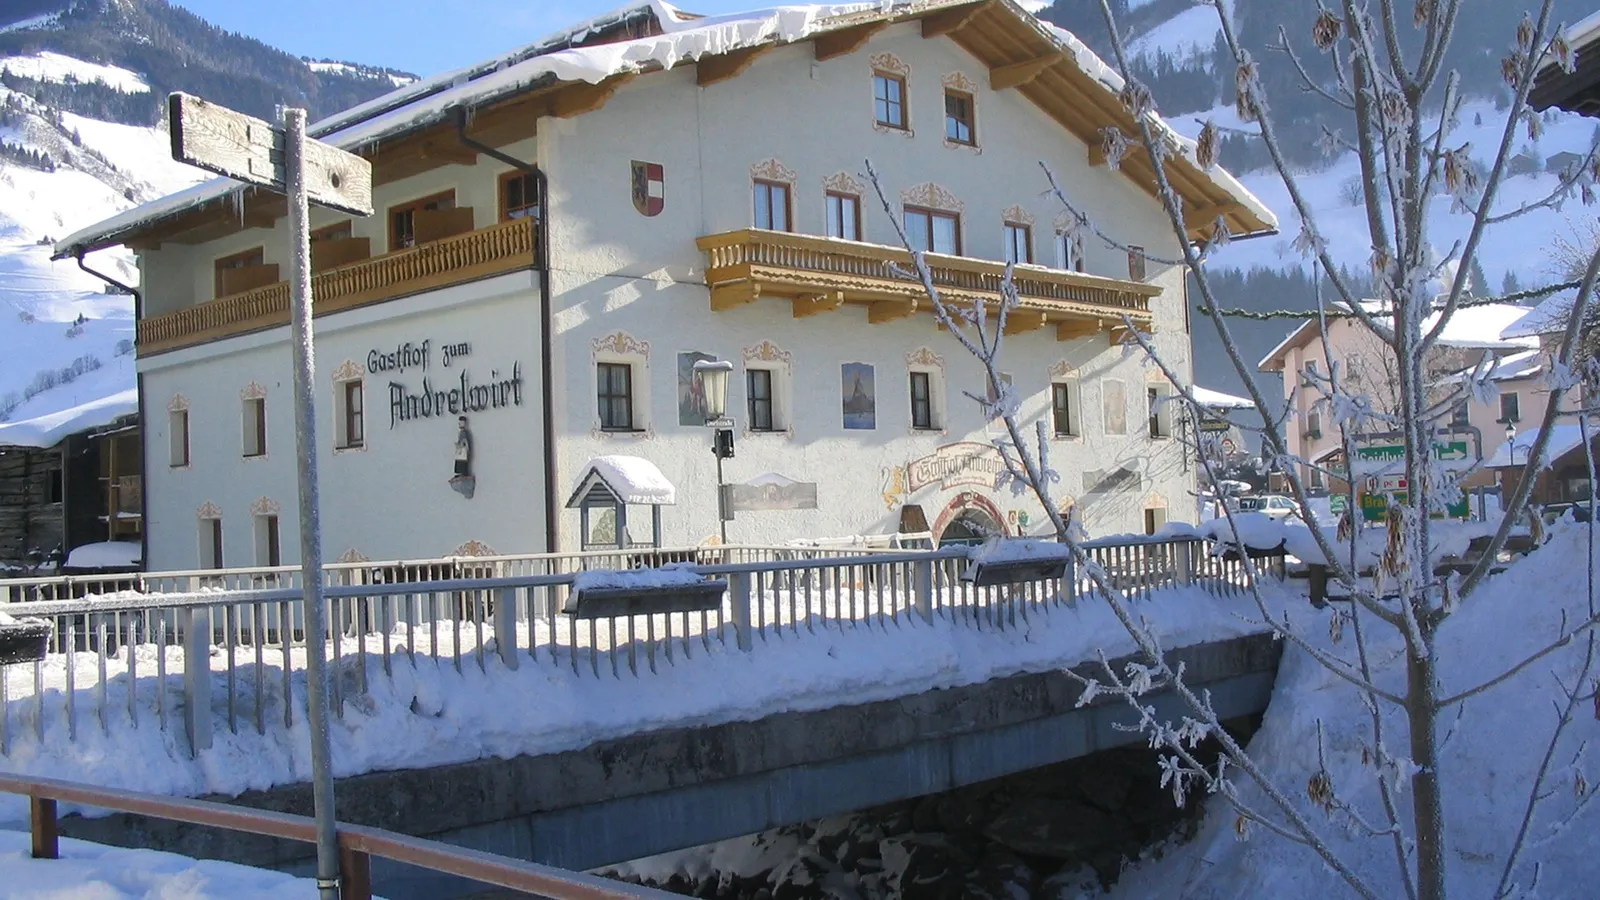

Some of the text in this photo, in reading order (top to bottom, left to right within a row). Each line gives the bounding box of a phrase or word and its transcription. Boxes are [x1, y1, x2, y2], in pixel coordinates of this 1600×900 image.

[367, 338, 470, 374] Gasthof zum
[388, 360, 523, 430] Andrelwirt
